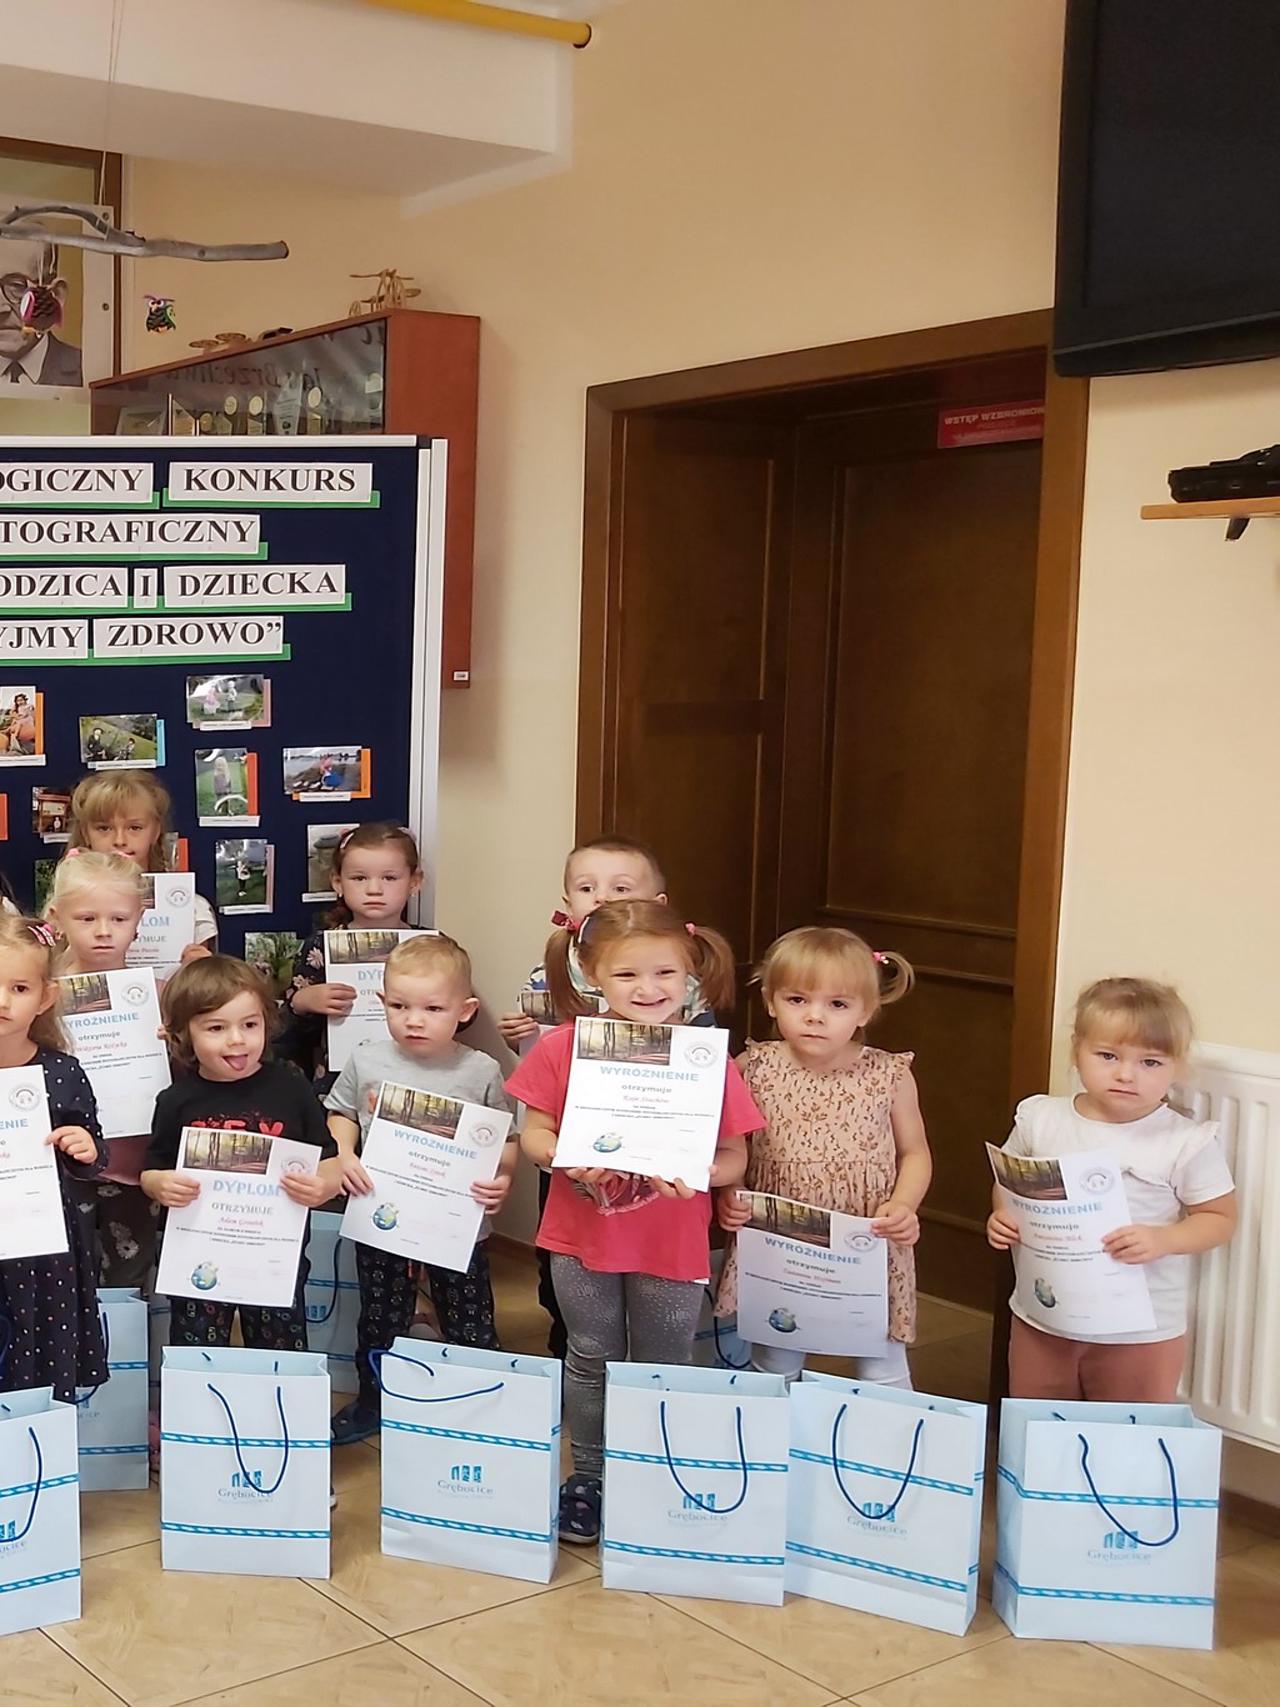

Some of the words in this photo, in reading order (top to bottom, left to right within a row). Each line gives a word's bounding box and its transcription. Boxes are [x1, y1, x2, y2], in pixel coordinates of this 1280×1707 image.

[184, 468, 357, 492] KONKURS
[140, 574, 151, 598] I
[178, 570, 338, 597] DZIECKA
[67, 1013, 139, 1028] YRÓŻNIENIE
